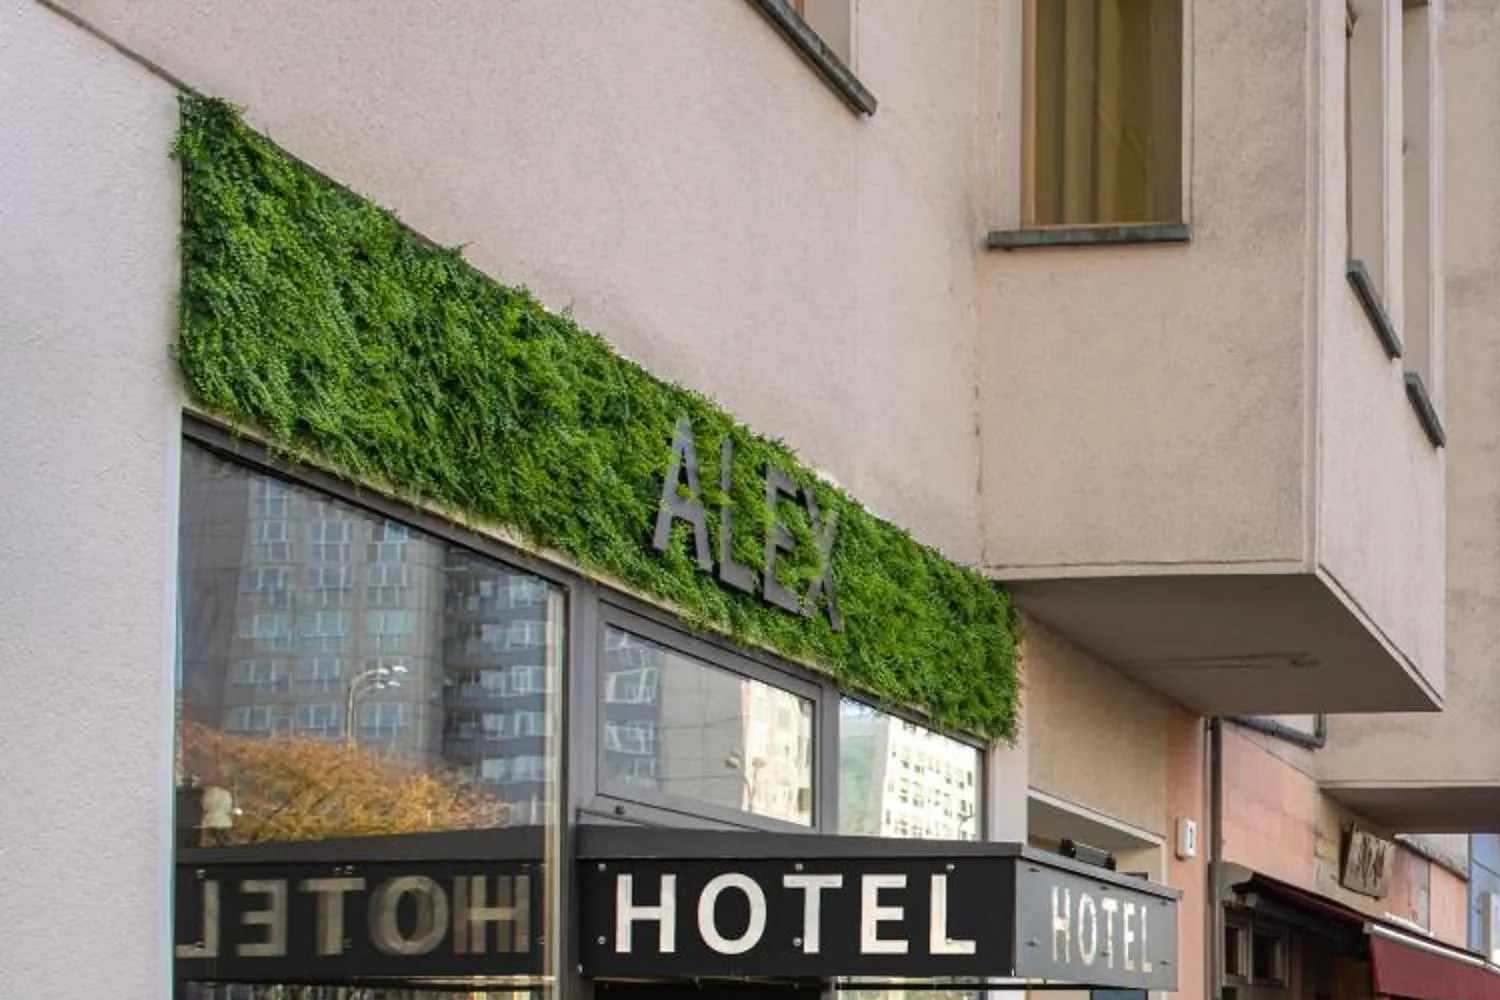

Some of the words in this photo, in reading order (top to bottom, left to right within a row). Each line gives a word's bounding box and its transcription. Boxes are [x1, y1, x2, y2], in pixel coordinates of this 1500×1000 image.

[652, 412, 843, 632] ALEX
[614, 873, 977, 955] HOTEL
[1051, 885, 1153, 973] HOTEL
